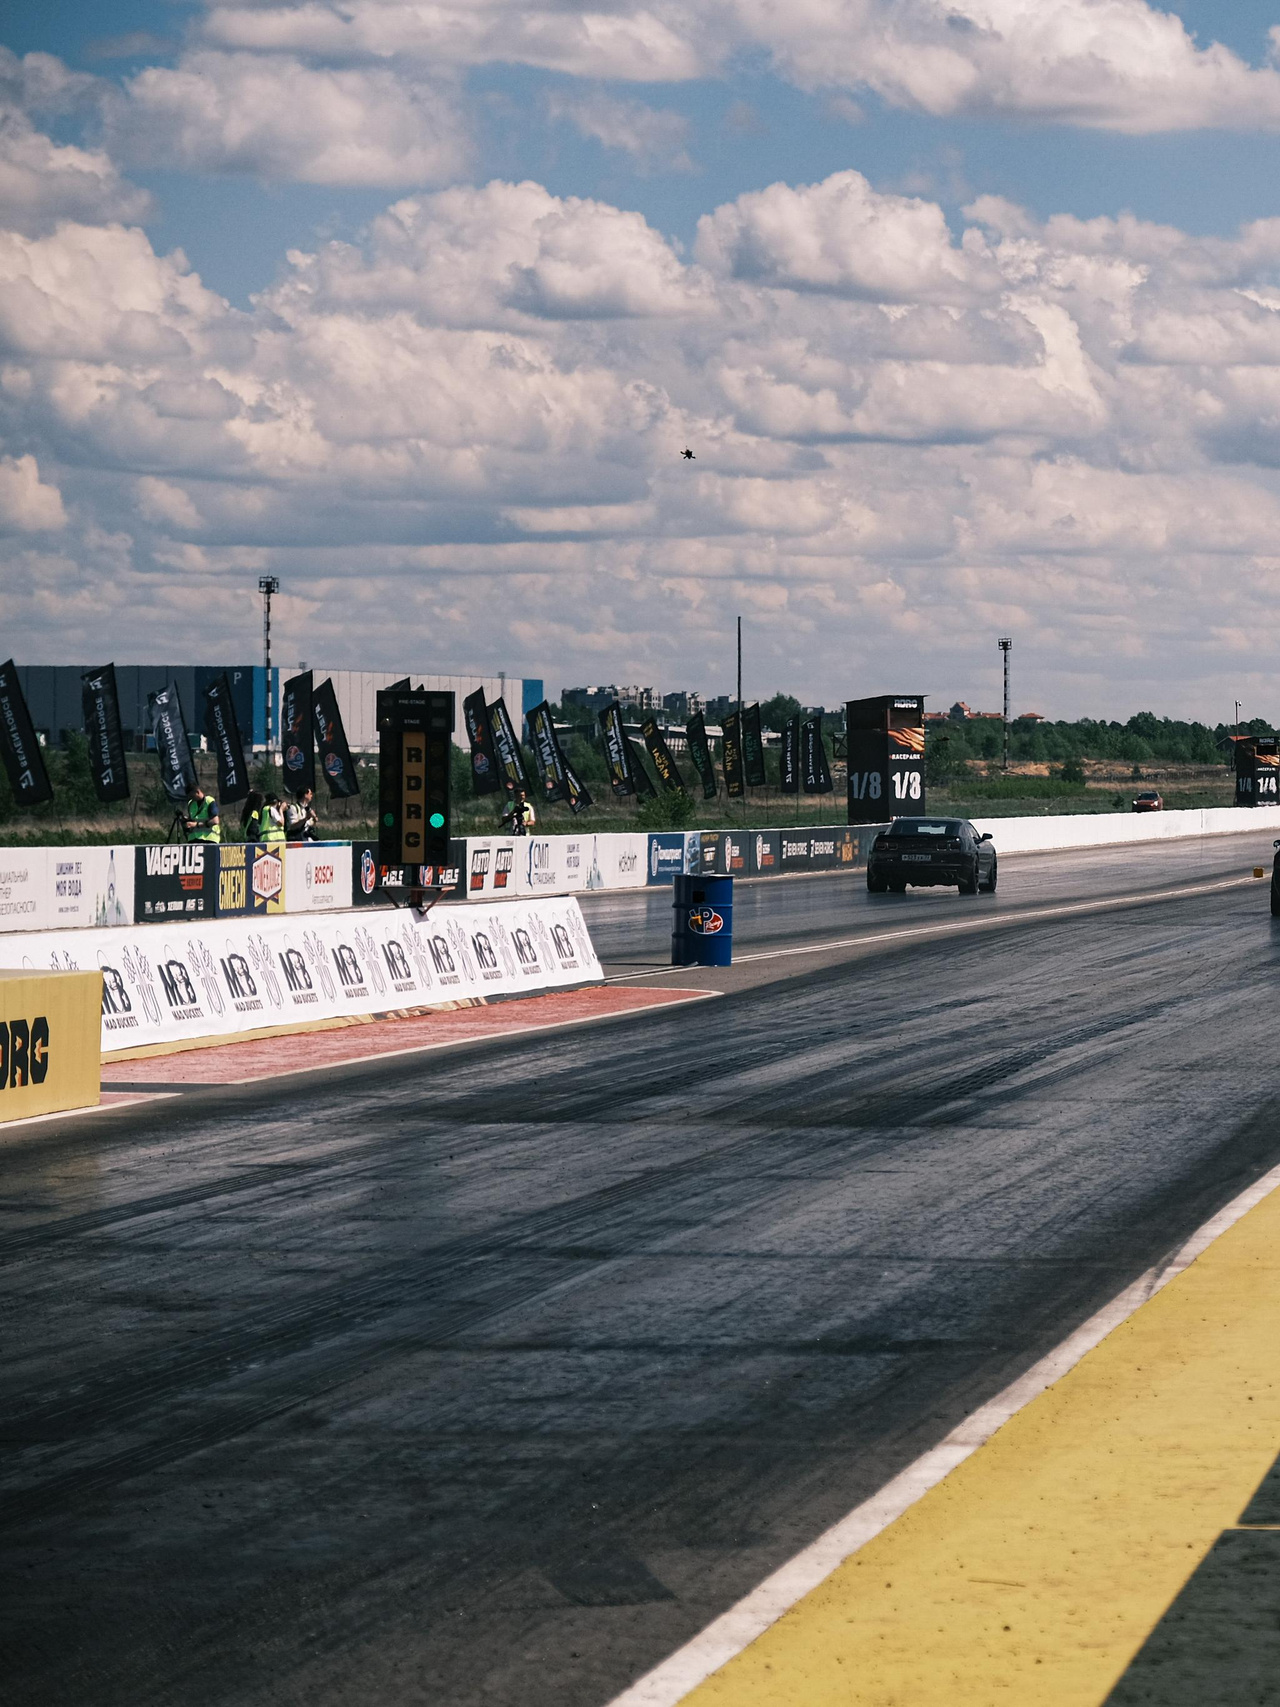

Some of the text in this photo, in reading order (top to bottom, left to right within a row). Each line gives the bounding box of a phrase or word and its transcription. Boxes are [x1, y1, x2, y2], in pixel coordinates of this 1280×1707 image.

[850, 772, 881, 800] 1/8
[892, 771, 921, 800] 1/8
[1239, 777, 1252, 792] 1/4
[1257, 777, 1278, 794] 1/4
[145, 846, 204, 876] VAGPLUS
[314, 865, 334, 884] BOSCH
[439, 868, 460, 884] FUELS
[68, 880, 82, 898] ВОДА
[219, 869, 246, 910] СМЕСИ
[172, 1007, 205, 1021] MAD BUCKETS
[234, 999, 264, 1012] MAD BUCKETS
[104, 1016, 139, 1031] MAD BUCKETS
